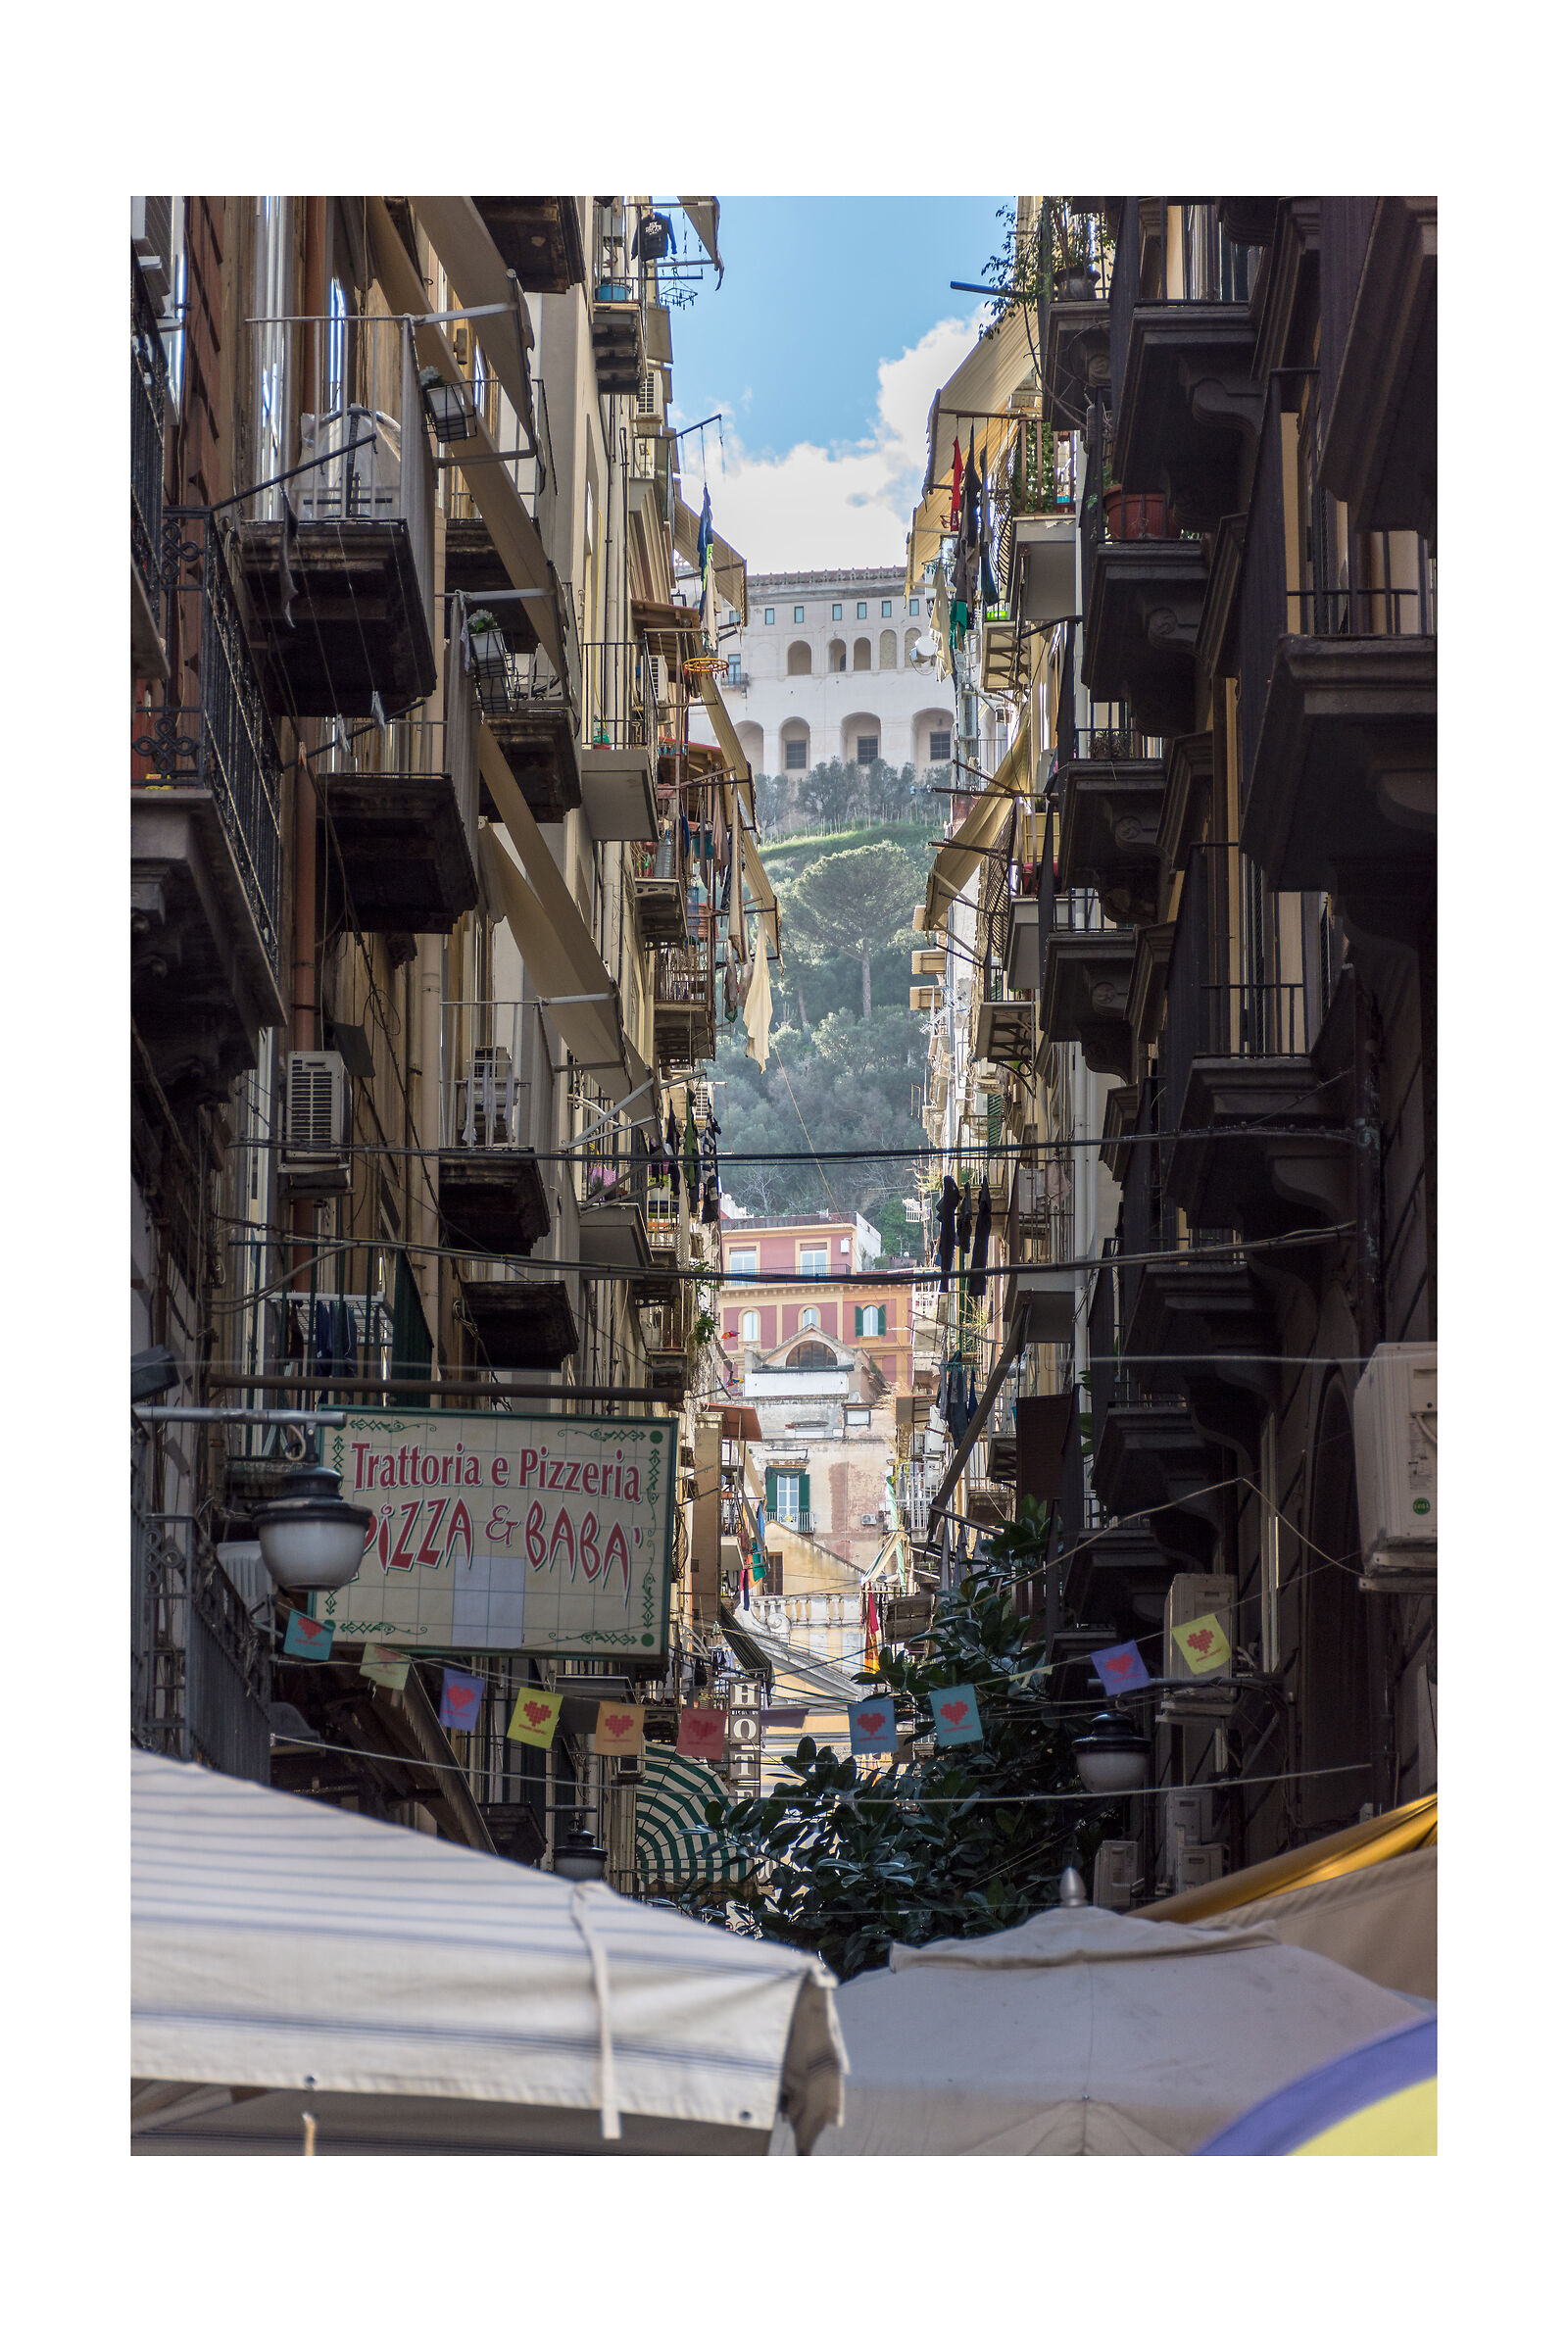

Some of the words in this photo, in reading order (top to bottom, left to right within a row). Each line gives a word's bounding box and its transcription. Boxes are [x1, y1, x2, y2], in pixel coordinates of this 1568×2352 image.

[350, 1442, 481, 1491] Trattoria
[491, 1456, 509, 1488] e
[518, 1446, 642, 1503] Pizzeria
[484, 1504, 519, 1546] &
